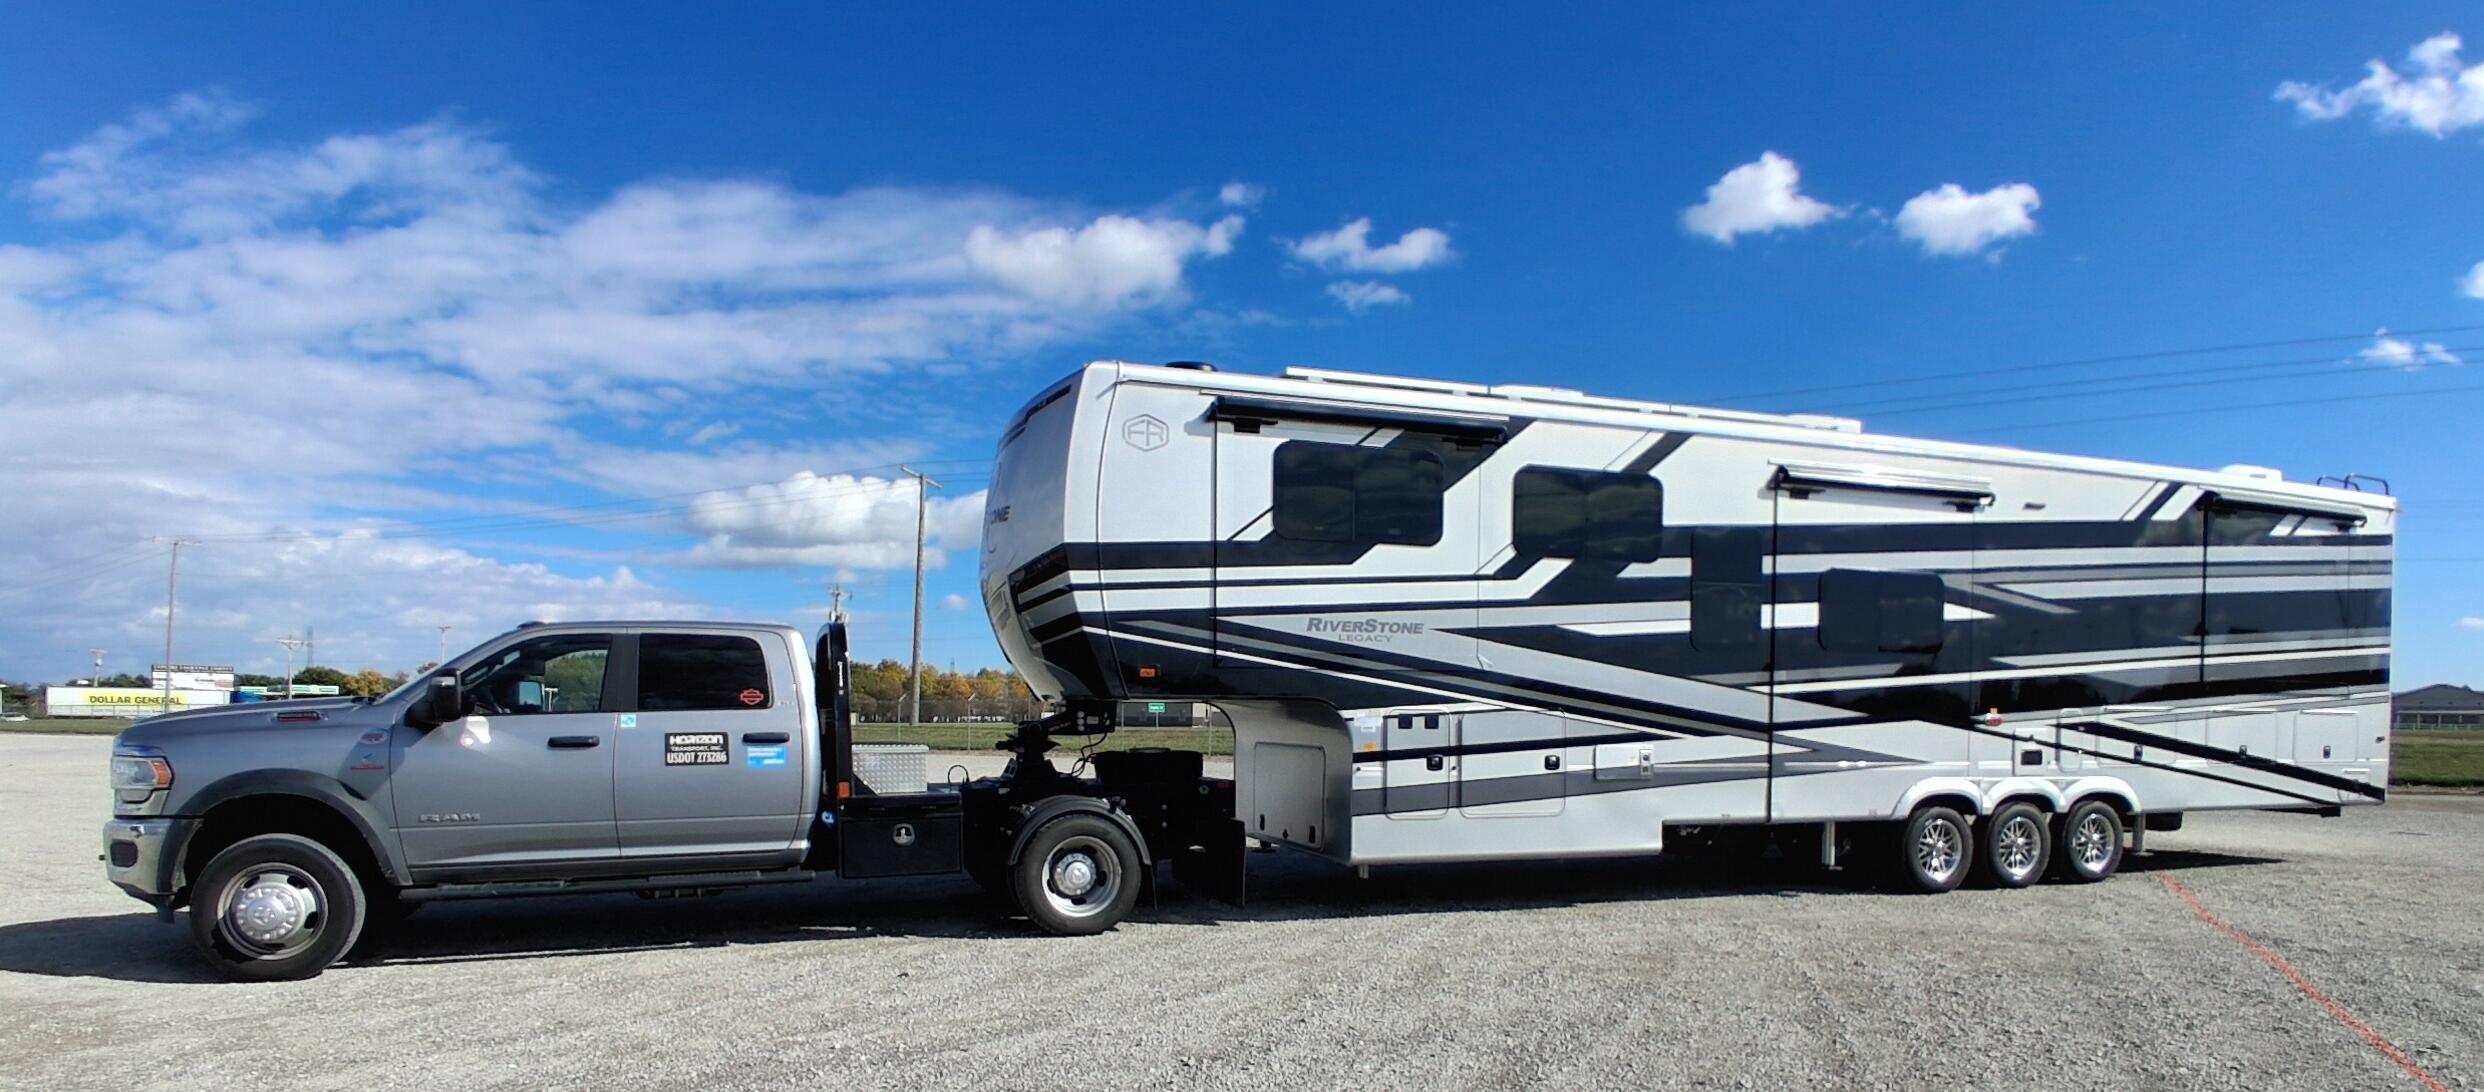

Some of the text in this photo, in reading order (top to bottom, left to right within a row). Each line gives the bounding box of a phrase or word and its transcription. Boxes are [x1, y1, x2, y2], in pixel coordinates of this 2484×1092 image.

[1338, 634, 1393, 642] LEGACY
[89, 695, 131, 704] DOLLAR
[666, 752, 696, 764] USDOT
[418, 812, 480, 823] RAM
